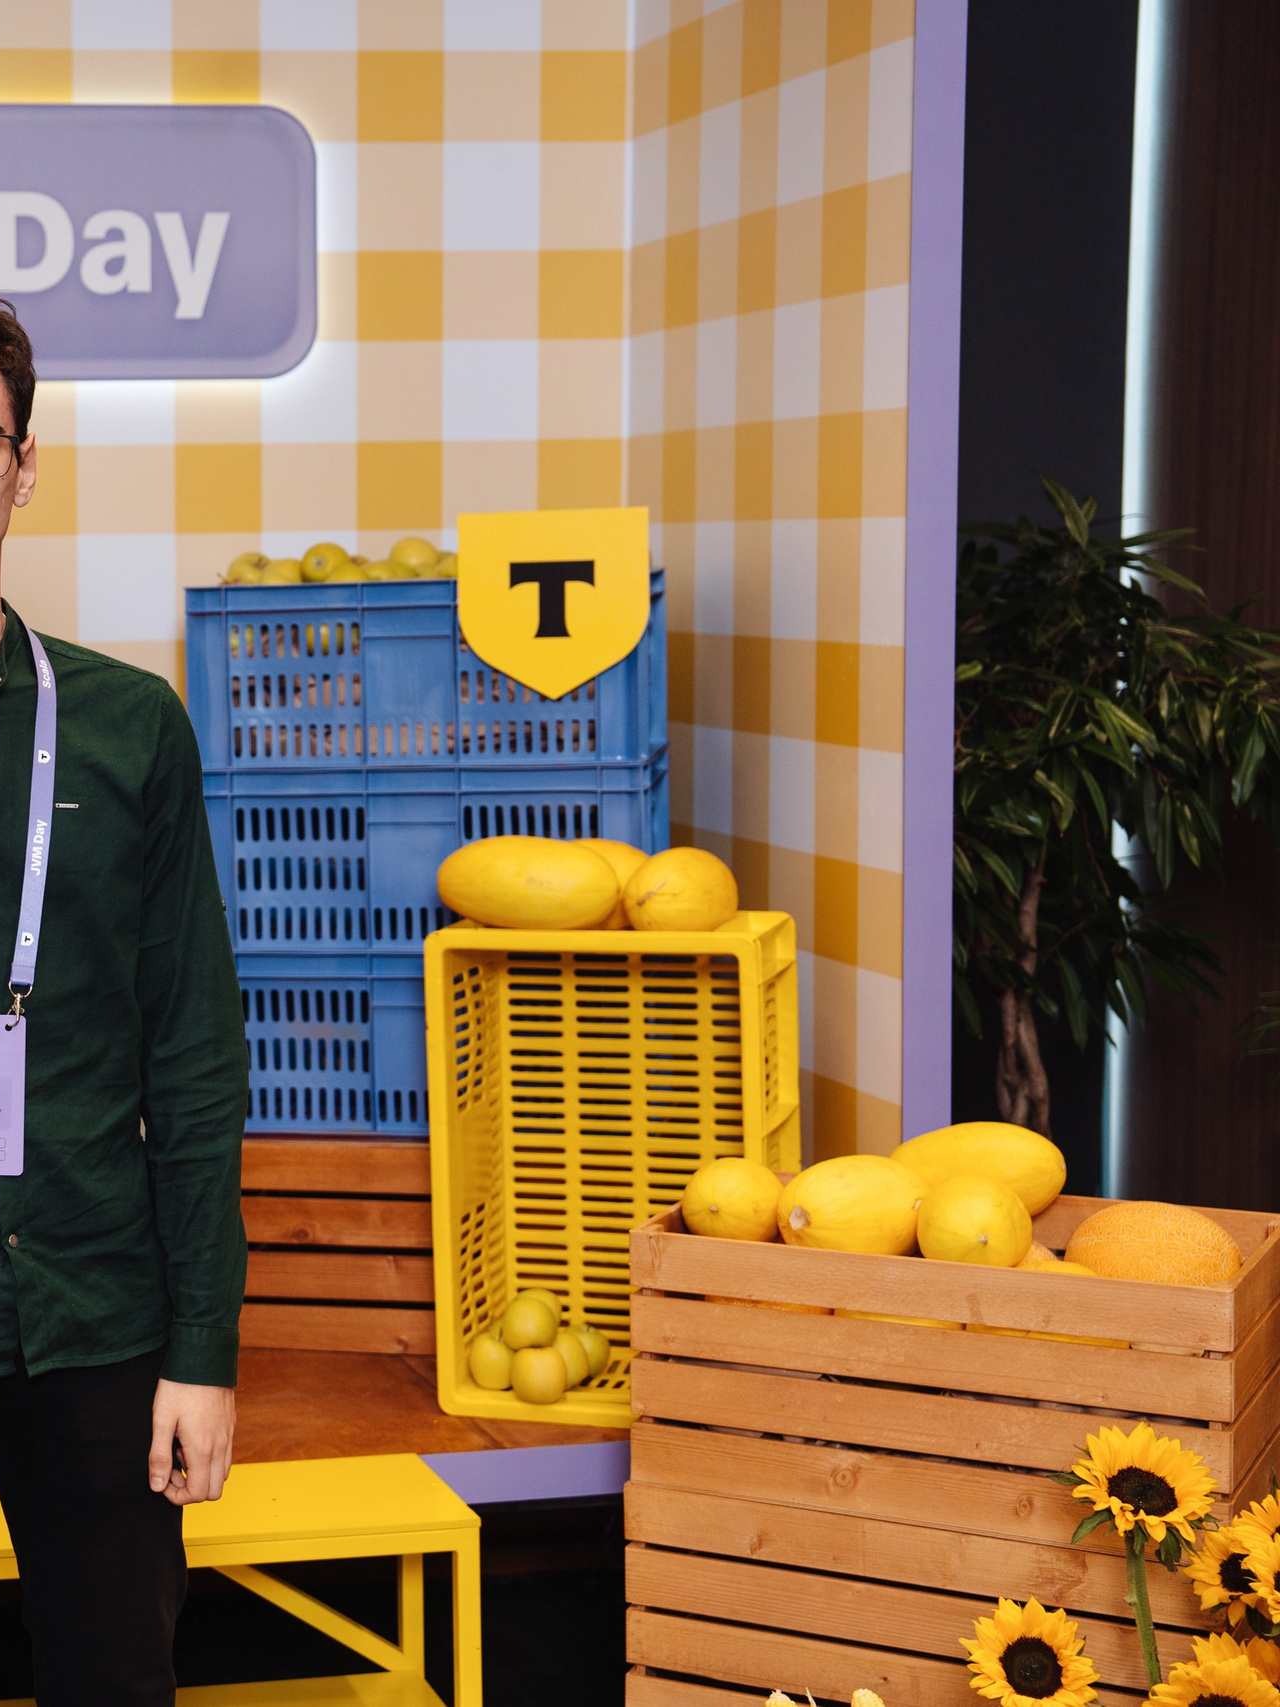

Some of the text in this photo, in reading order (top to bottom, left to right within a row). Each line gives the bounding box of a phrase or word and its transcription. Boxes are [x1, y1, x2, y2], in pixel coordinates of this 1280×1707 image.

[509, 560, 595, 638] T
[40, 660, 51, 688] Scala
[30, 819, 48, 876] JVM Day
